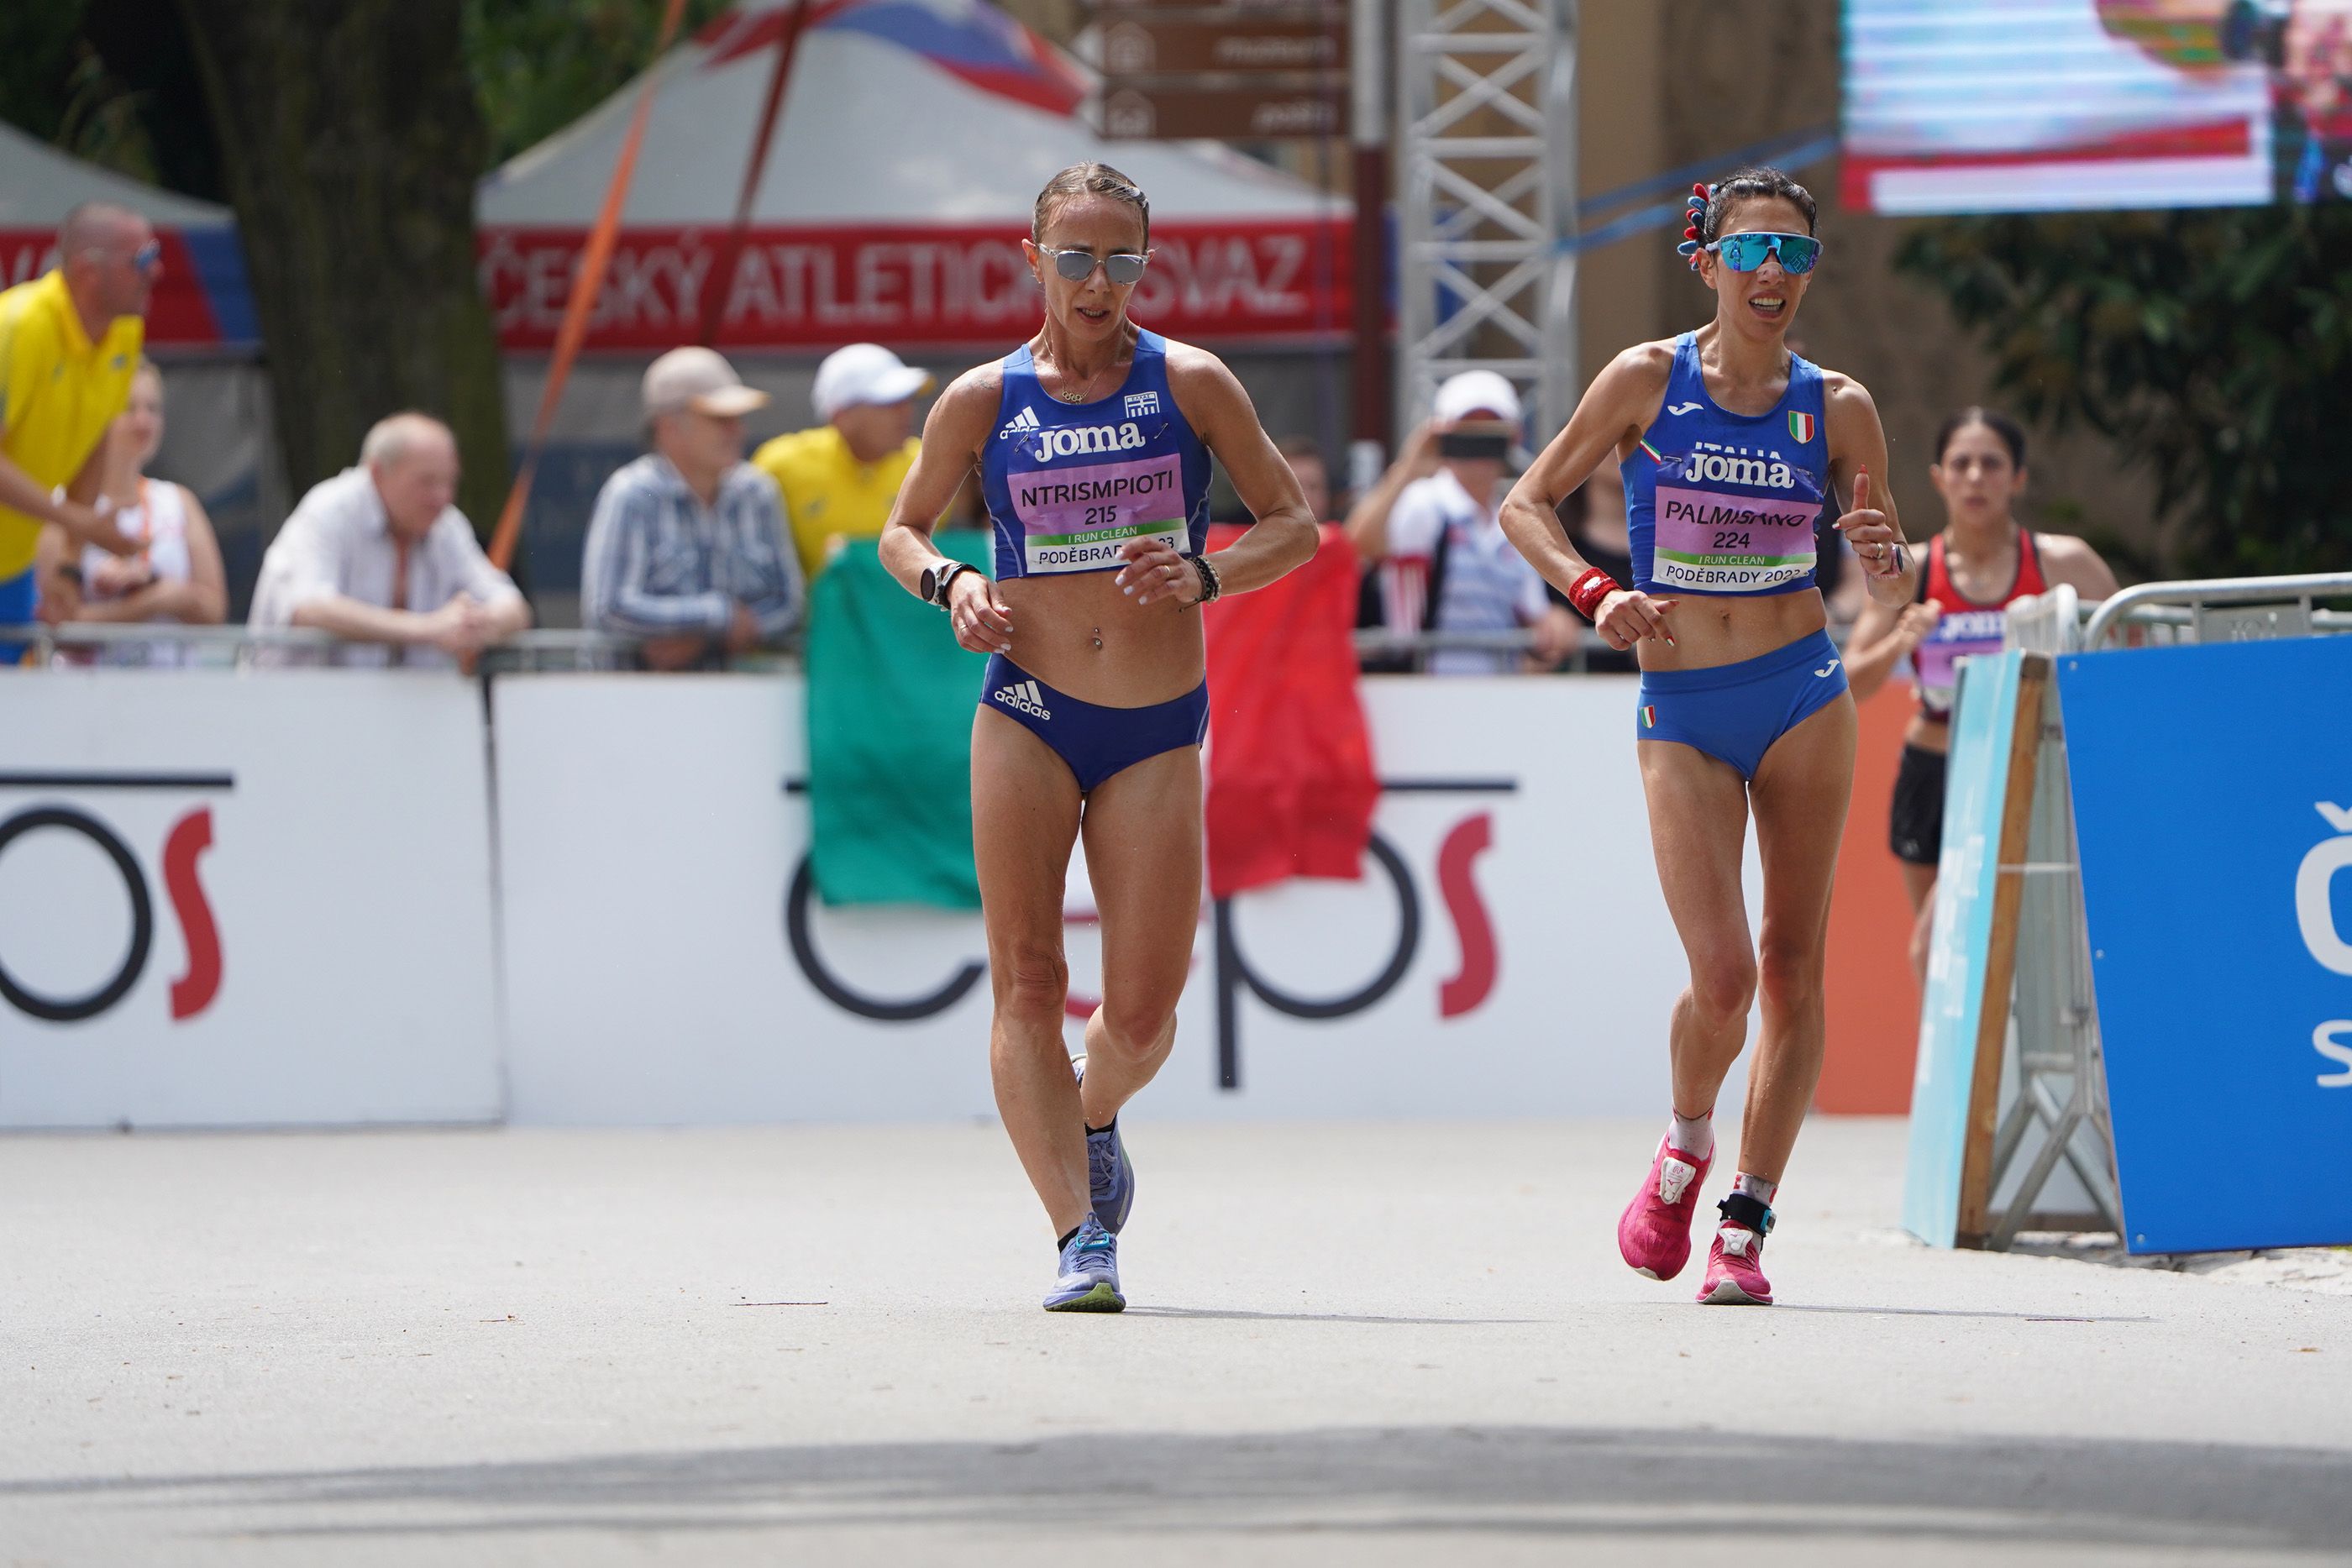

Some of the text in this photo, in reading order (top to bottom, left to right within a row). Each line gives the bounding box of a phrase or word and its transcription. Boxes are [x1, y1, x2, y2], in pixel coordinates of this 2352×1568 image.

[1021, 470, 1173, 507] NTRISMPIOTI
[1084, 505, 1117, 526] 215
[1068, 526, 1137, 544] I RUN CLEAN
[1713, 532, 1751, 548] 224
[1698, 555, 1765, 565] I RUN CLEAN
[1666, 564, 1761, 584] PODĚBRADY
[994, 690, 1051, 721] adidas
